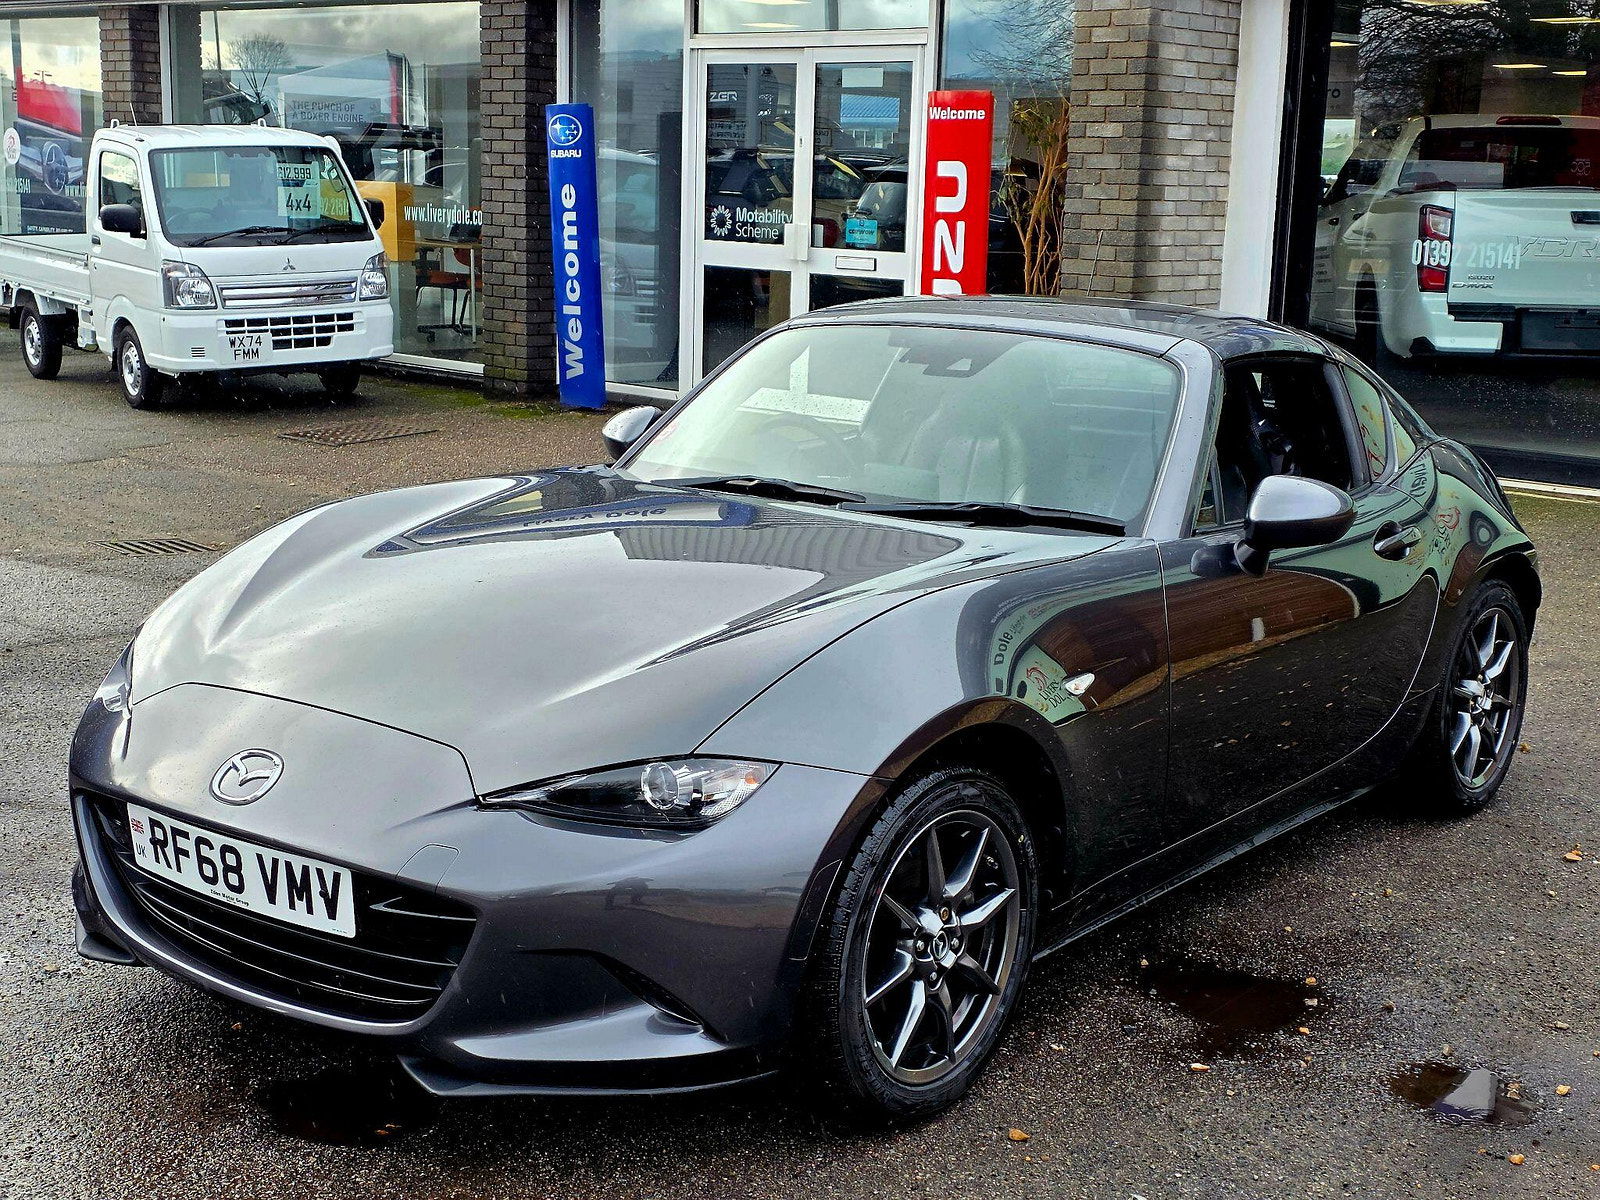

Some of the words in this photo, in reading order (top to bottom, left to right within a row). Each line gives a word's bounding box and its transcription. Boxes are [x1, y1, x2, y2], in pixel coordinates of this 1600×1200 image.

[293, 101, 309, 109] THE
[312, 102, 341, 111] PUNCH
[344, 104, 355, 112] OF
[929, 106, 986, 120] Welcome
[301, 112, 329, 120] BOXER
[550, 149, 582, 158] SUBARU
[285, 193, 312, 211] 4x4
[404, 203, 482, 227] www.liverydole.co
[736, 206, 793, 224] Motability
[735, 223, 779, 239] Scheme
[1411, 239, 1463, 268] 01392
[1466, 242, 1522, 270] 215141
[560, 183, 585, 380] Welcome
[229, 335, 262, 348] WX74
[234, 348, 260, 360] FMM
[994, 631, 1014, 666] Dole
[136, 843, 147, 859] UK
[148, 816, 246, 895] RF68
[255, 852, 342, 921] VMV
